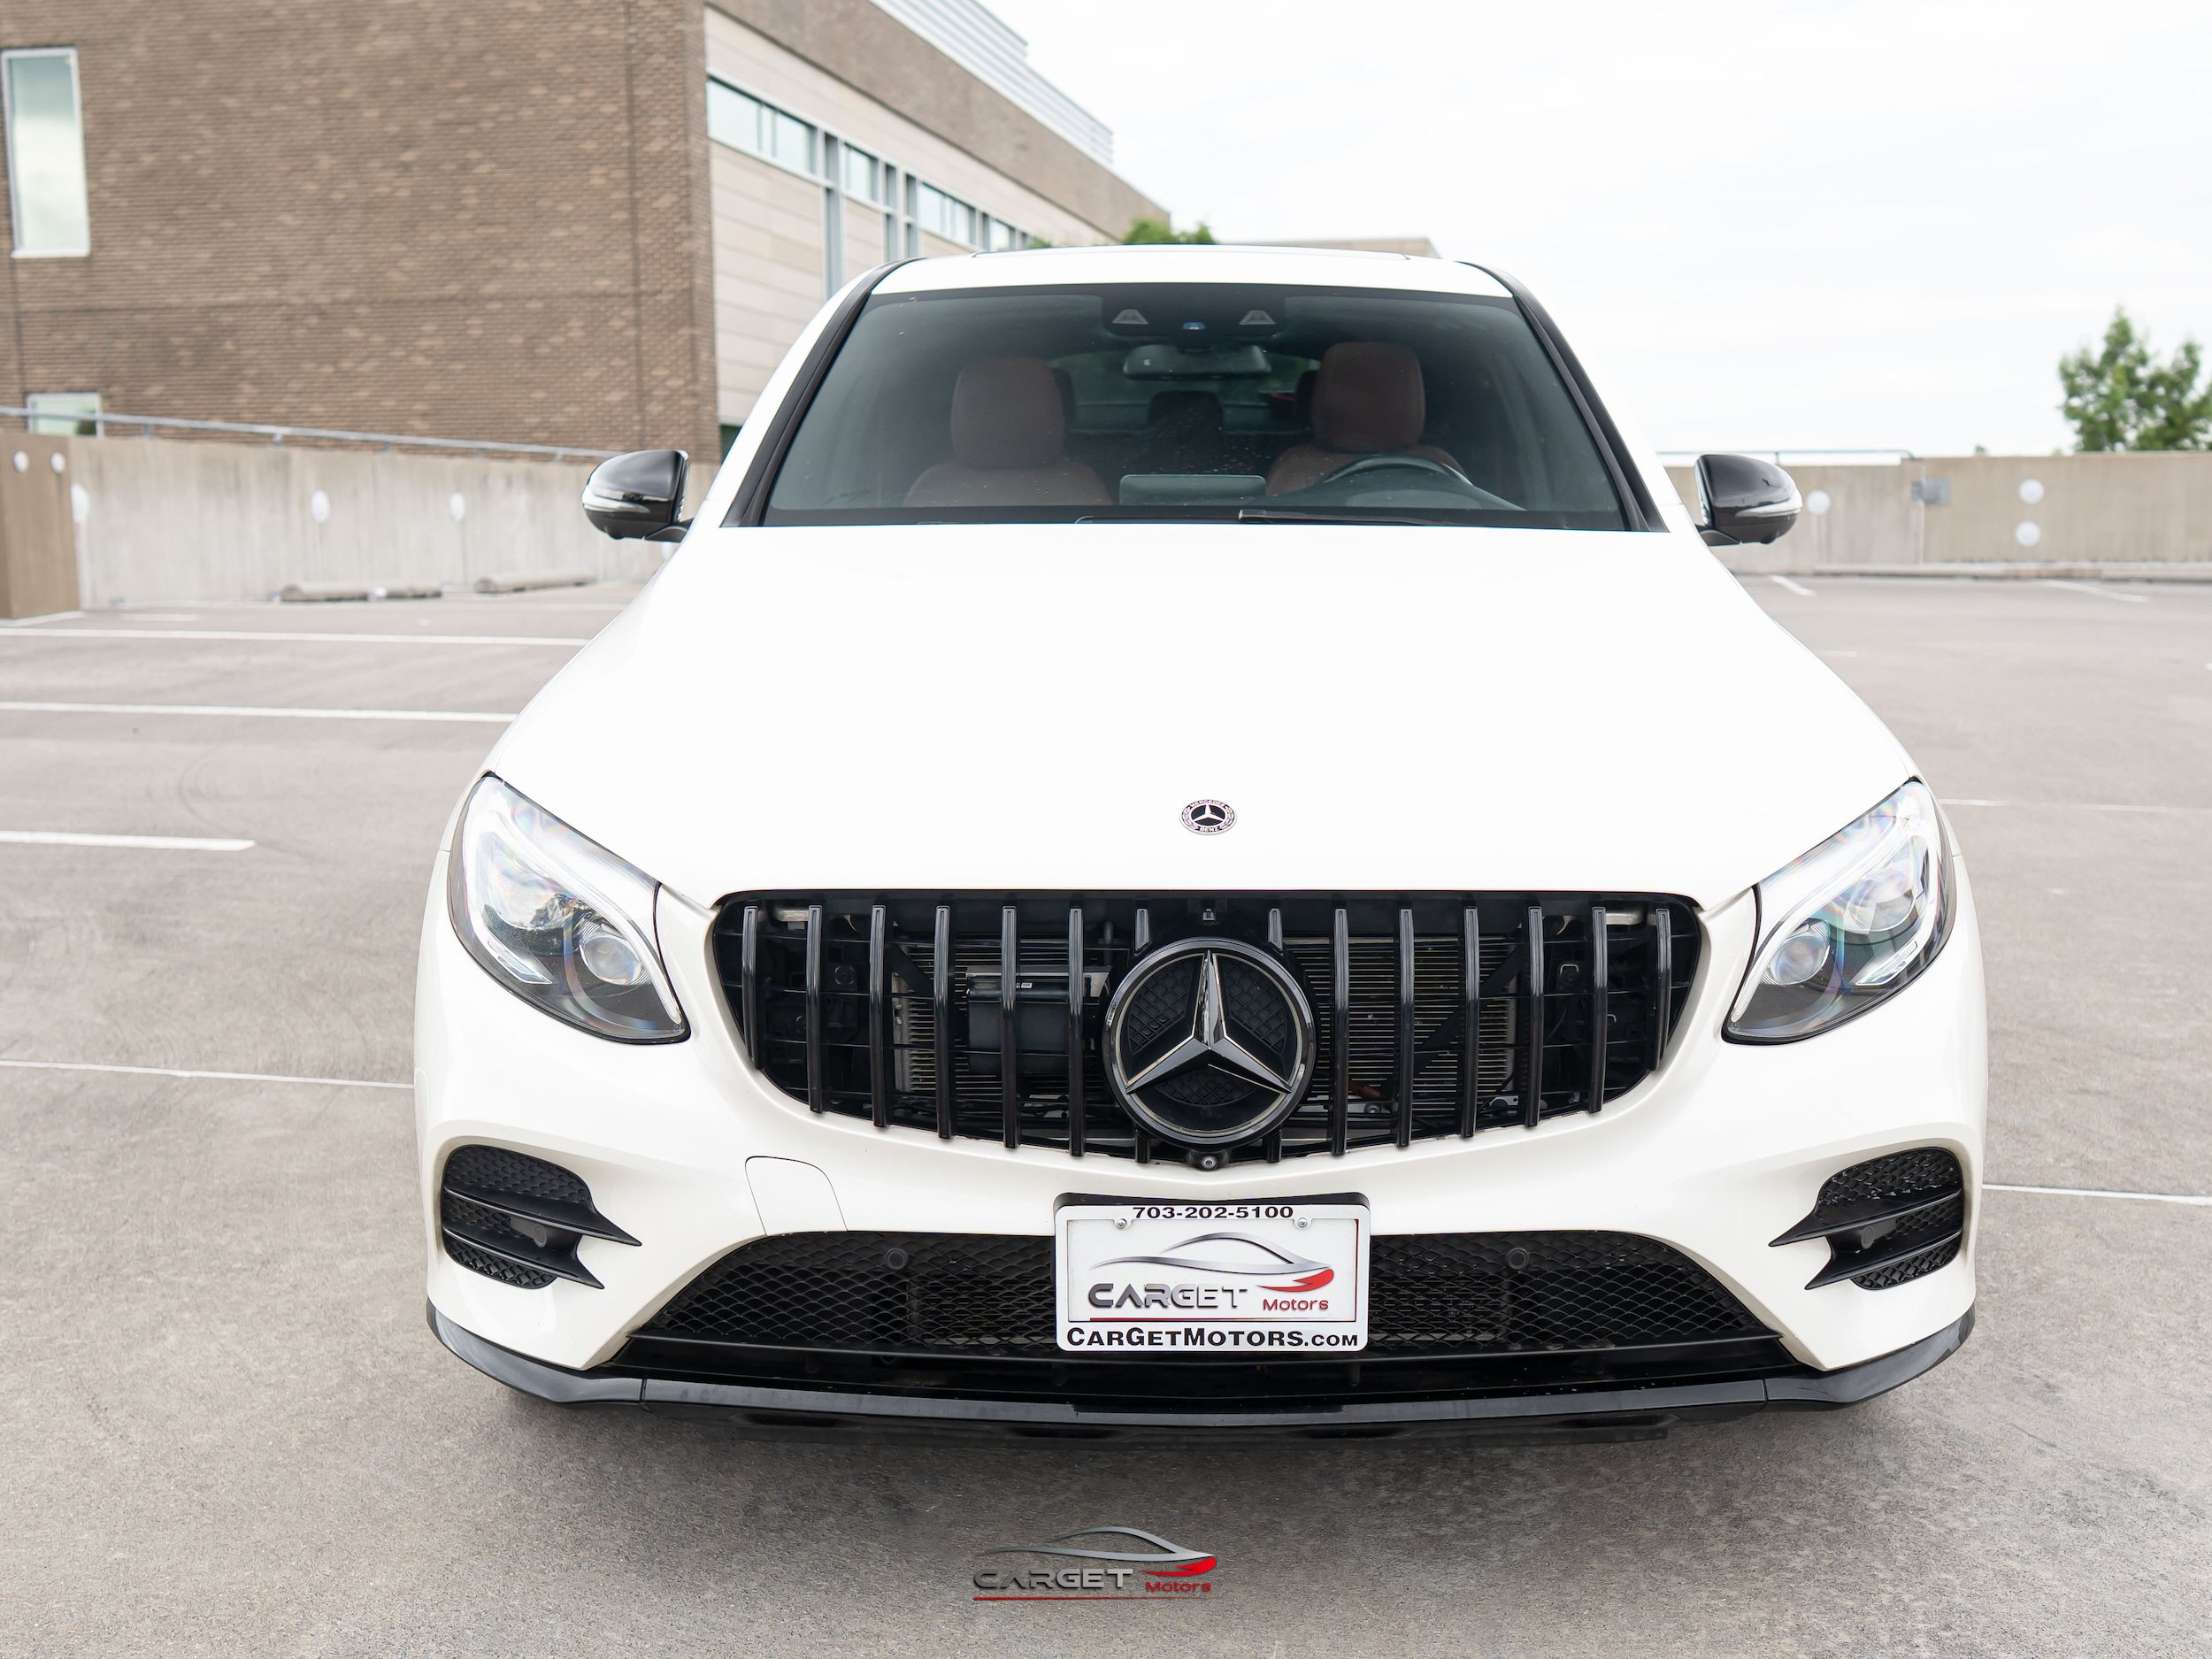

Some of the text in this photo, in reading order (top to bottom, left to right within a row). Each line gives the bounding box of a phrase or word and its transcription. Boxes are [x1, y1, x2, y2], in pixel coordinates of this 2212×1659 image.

[1133, 1206, 1294, 1218] 703-202-5100
[1088, 1283, 1248, 1309] CARGET
[1263, 1298, 1329, 1311] Motors
